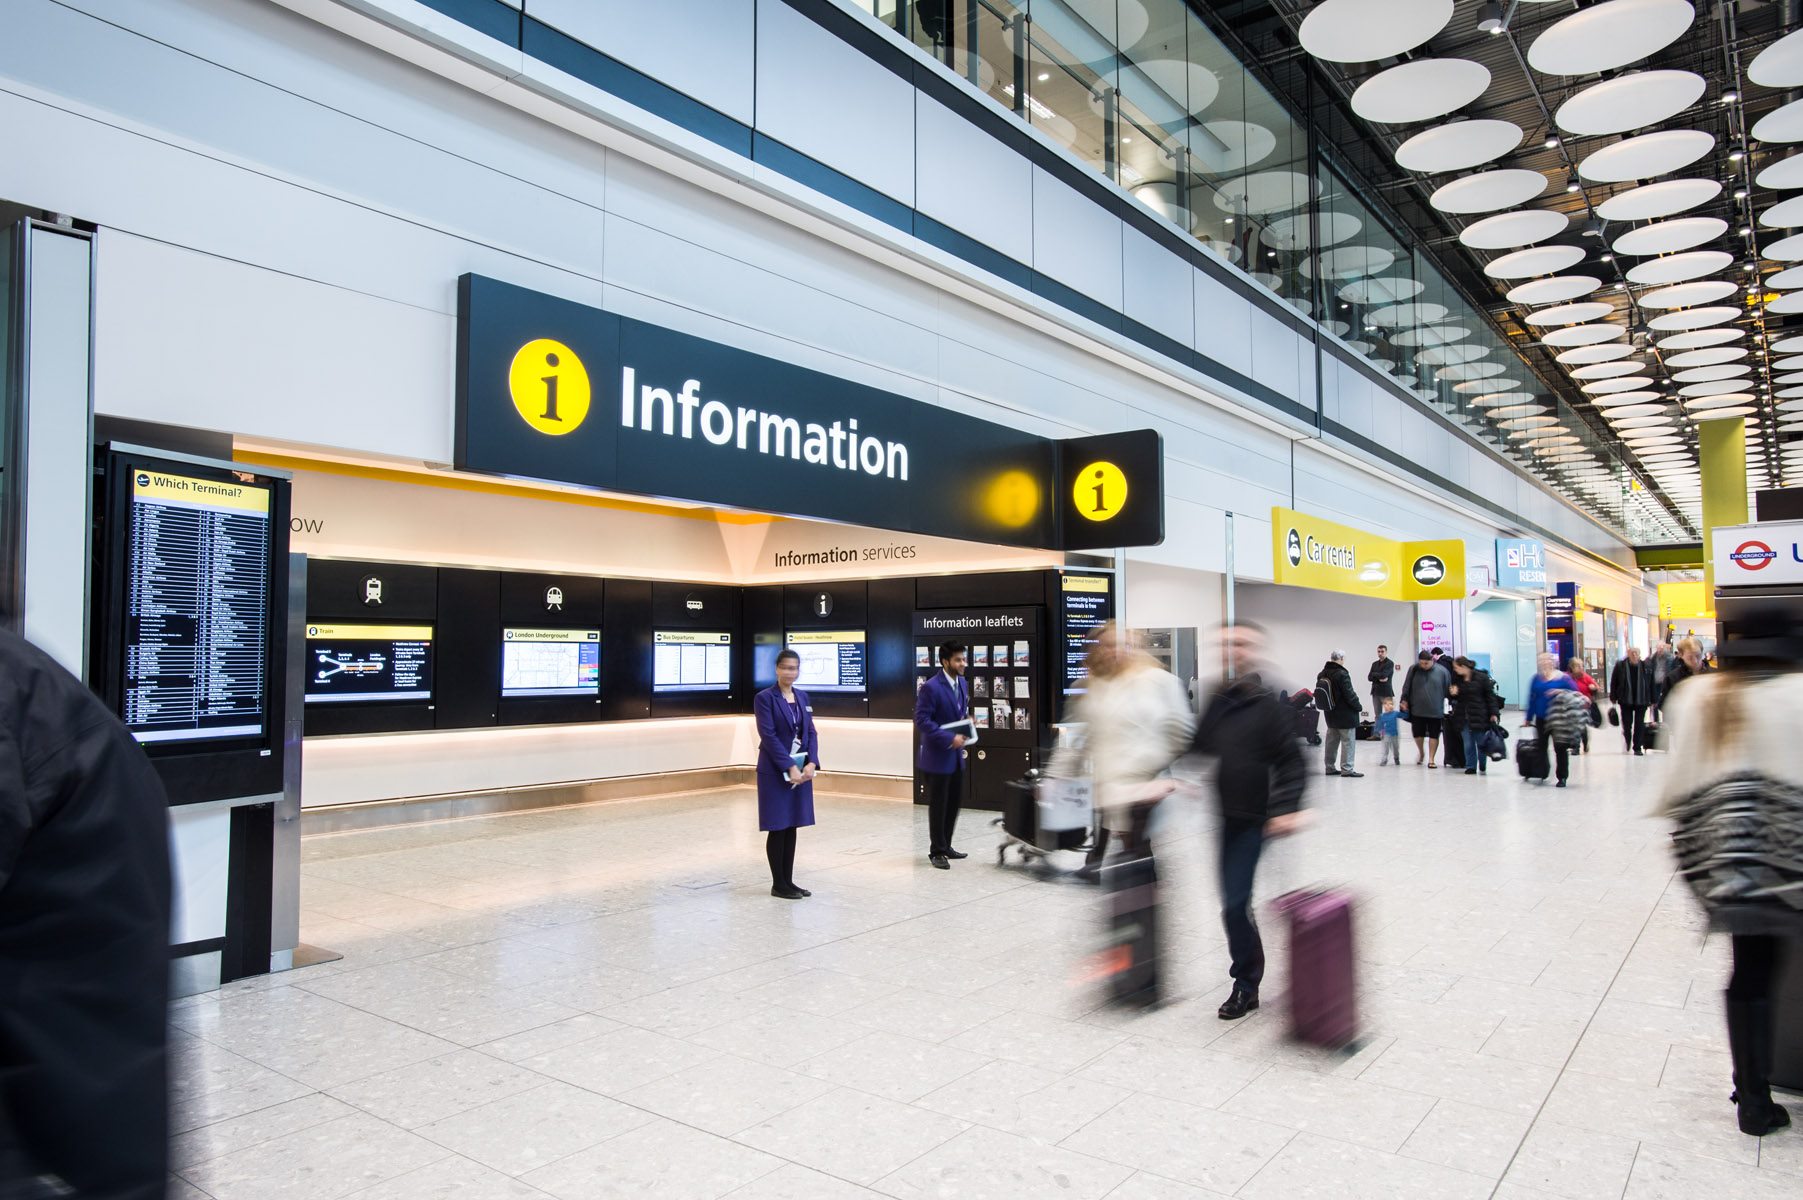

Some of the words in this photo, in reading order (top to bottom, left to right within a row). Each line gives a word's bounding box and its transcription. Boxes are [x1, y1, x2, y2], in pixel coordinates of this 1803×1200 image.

[621, 365, 909, 482] Information
[154, 476, 189, 491] Which
[192, 482, 242, 498] Terminal?
[774, 548, 858, 568] Information
[862, 542, 916, 562] services
[1305, 535, 1326, 562] Car
[1326, 544, 1356, 570] rental
[1732, 552, 1776, 560] UNDERGROUND
[924, 616, 982, 630] Information
[984, 616, 1024, 628] leaflets
